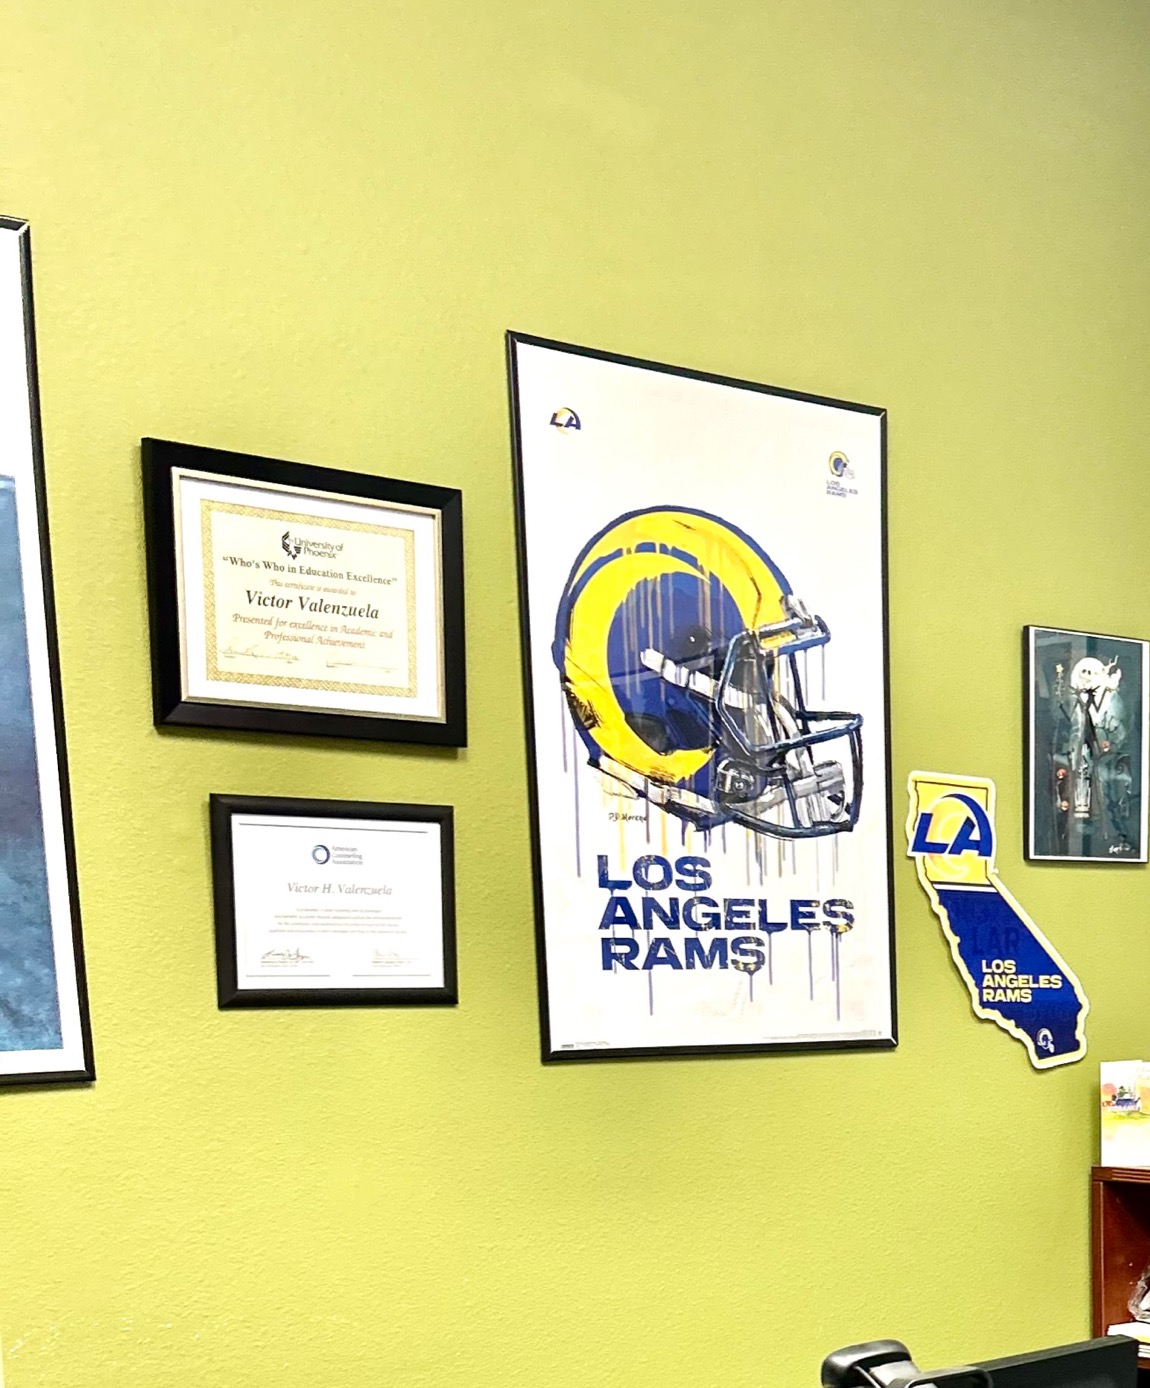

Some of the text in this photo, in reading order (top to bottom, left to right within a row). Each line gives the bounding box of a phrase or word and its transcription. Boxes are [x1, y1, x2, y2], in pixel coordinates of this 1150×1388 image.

[550, 407, 581, 430] LA
[294, 537, 344, 551] University of
[303, 546, 337, 559] Phoenix
[262, 560, 285, 572] Who
[287, 564, 297, 573] in
[299, 565, 344, 580] Education
[245, 589, 380, 619] Victor Valenzuela
[232, 613, 273, 627] Presented
[275, 618, 288, 629] for
[289, 620, 328, 633] excellence
[379, 629, 393, 639] and
[264, 630, 365, 649] Professional Achievement
[911, 793, 993, 857] LA
[597, 855, 712, 891] LOS
[287, 881, 320, 893] Victor
[338, 884, 393, 896] Valenzuela
[598, 896, 855, 934] ANGELES
[601, 936, 766, 974] RAMS
[981, 959, 1016, 974] LOS
[982, 975, 1063, 989] ANGELES
[982, 989, 1033, 1003] RAMS
